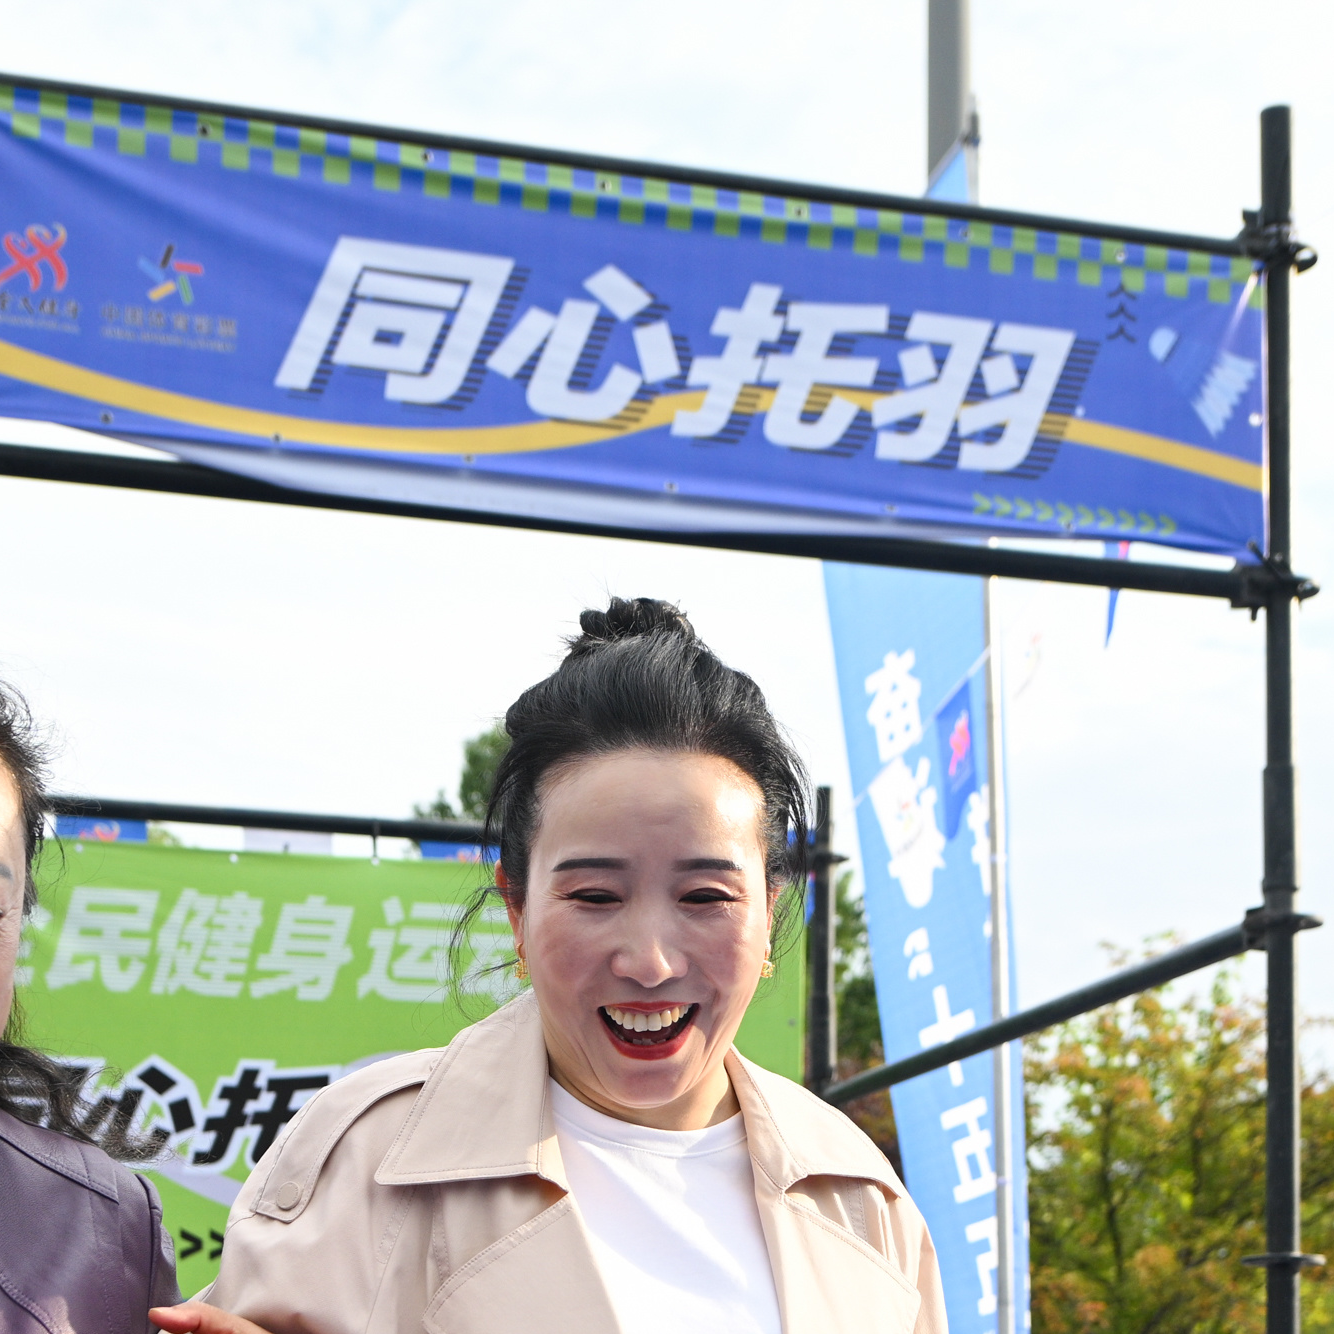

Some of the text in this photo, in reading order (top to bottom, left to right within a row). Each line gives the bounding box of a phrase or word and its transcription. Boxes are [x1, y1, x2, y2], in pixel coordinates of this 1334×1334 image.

[275, 235, 1077, 473] 同心托羽
[14, 884, 522, 1003] 民健身运
